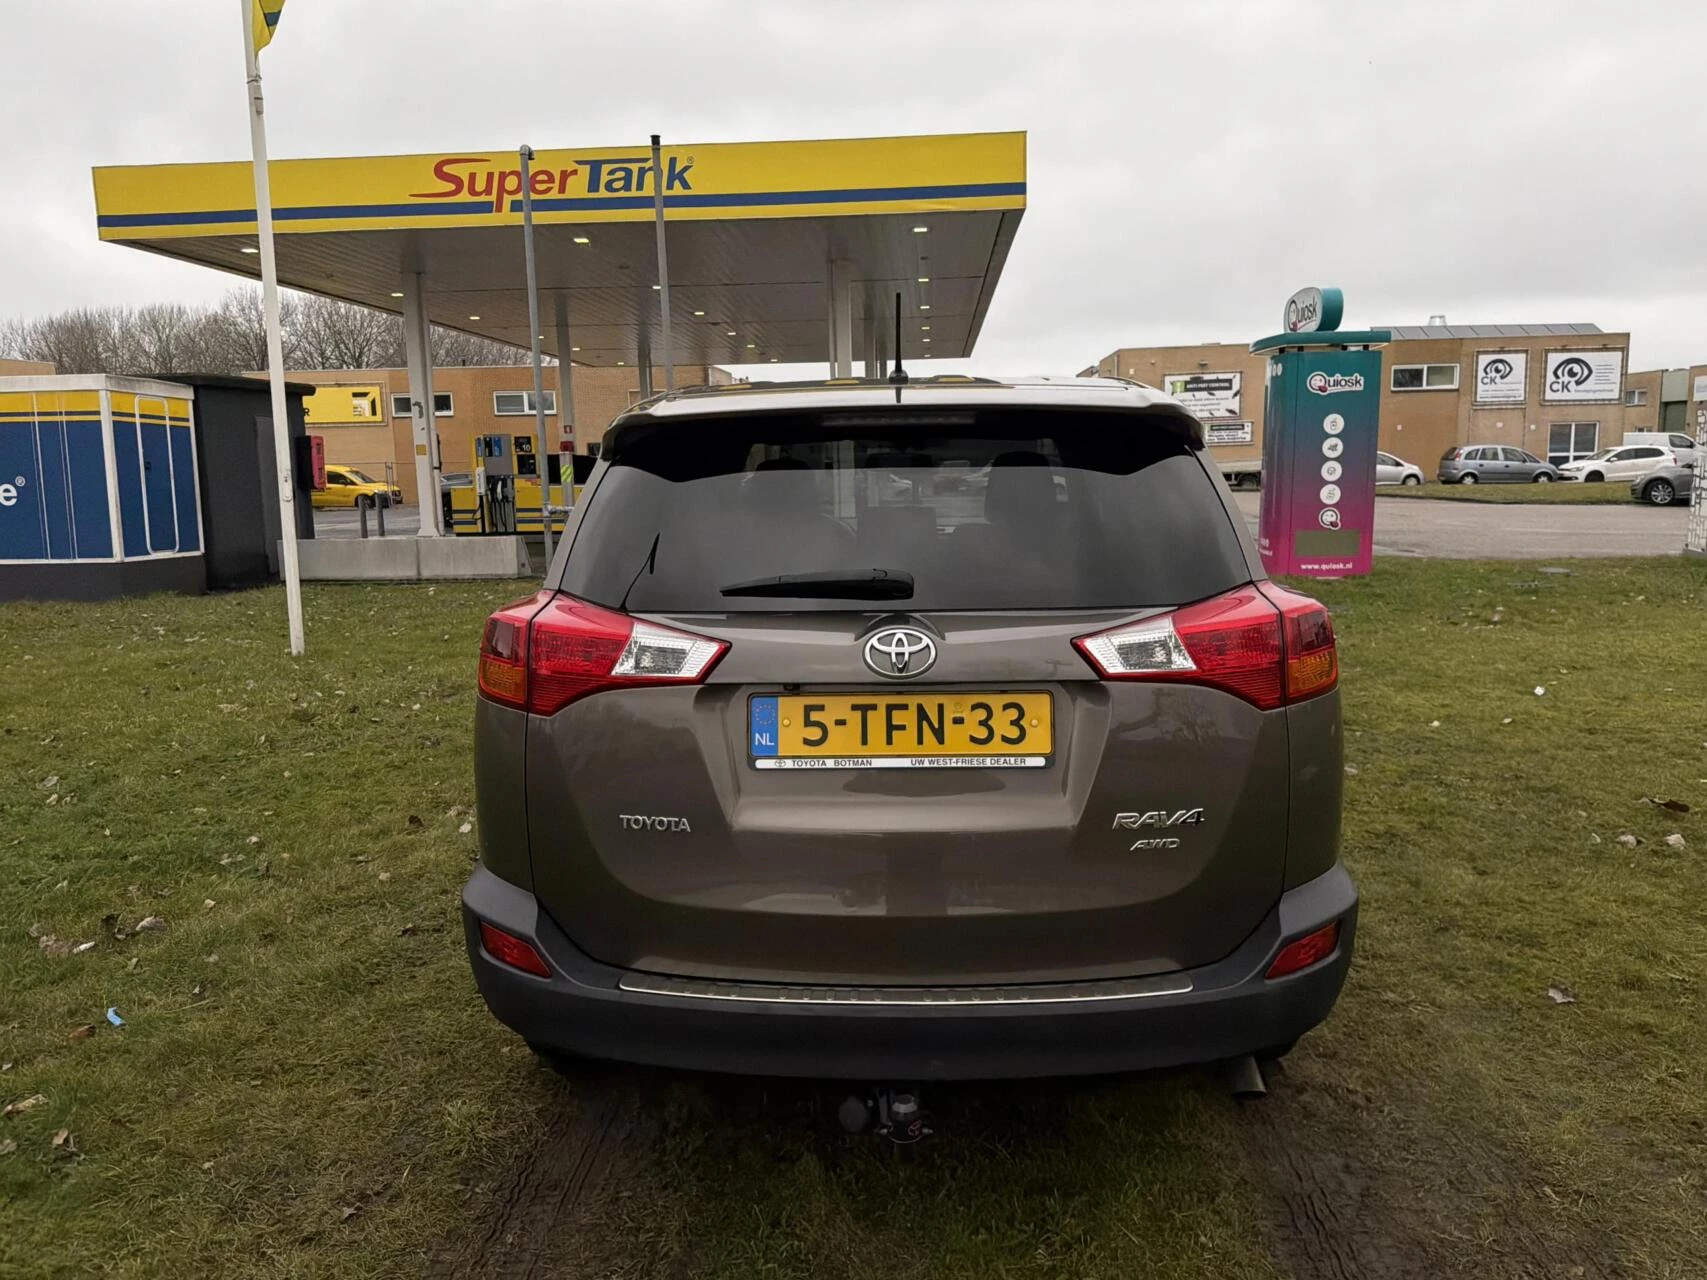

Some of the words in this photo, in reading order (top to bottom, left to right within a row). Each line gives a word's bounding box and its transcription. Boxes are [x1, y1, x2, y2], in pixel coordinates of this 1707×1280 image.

[1288, 296, 1318, 332] Quiosk
[1309, 373, 1363, 393] Quiosk
[1481, 375, 1498, 385] CK
[1550, 380, 1572, 393] CK
[1301, 562, 1353, 571] www.quiosk.nl
[802, 702, 1027, 746] 5-TFN-33
[755, 733, 774, 746] NL
[792, 759, 827, 767] TOYOTA
[834, 759, 872, 767] BOTMAN
[911, 758, 926, 766] UW
[929, 758, 987, 766] WEST-FRIESE
[990, 758, 1026, 766] DEALER
[619, 814, 691, 832] TOYOTA
[1112, 808, 1205, 830] RAV4
[1130, 838, 1180, 851] AWD
